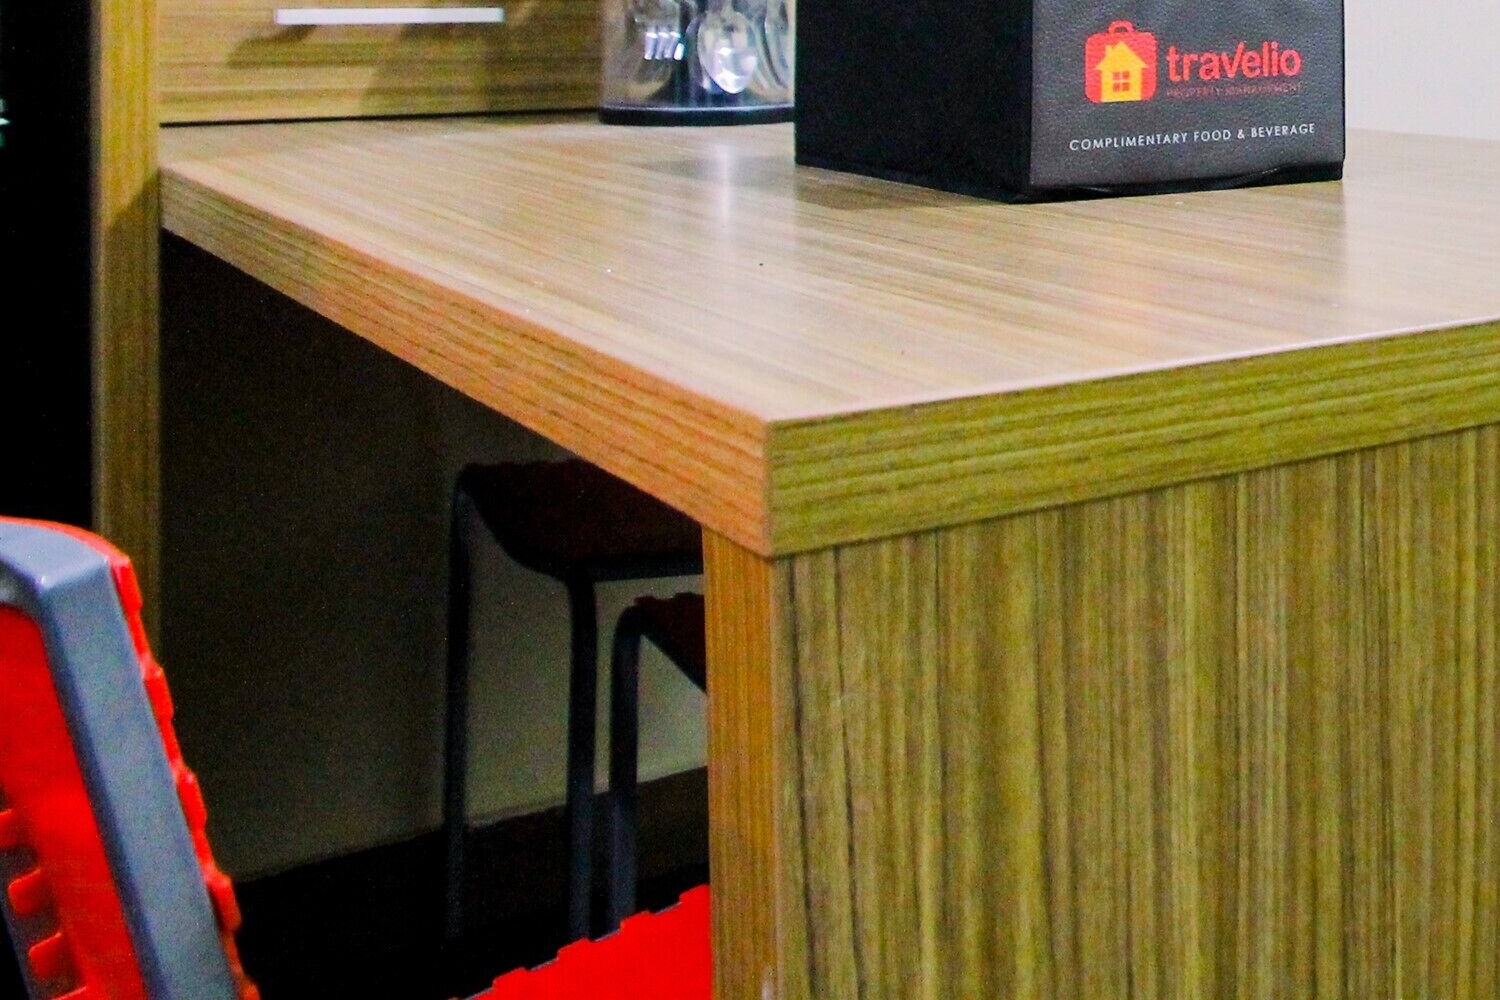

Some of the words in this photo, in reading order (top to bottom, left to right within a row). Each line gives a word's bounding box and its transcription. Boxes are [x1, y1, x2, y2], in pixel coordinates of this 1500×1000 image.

[1166, 40, 1302, 82] travelio
[1069, 131, 1188, 151] COMPLIMENTARY
[1193, 129, 1232, 142] FOOD
[1237, 128, 1246, 139] &
[1251, 123, 1316, 138] BEVERAGE
